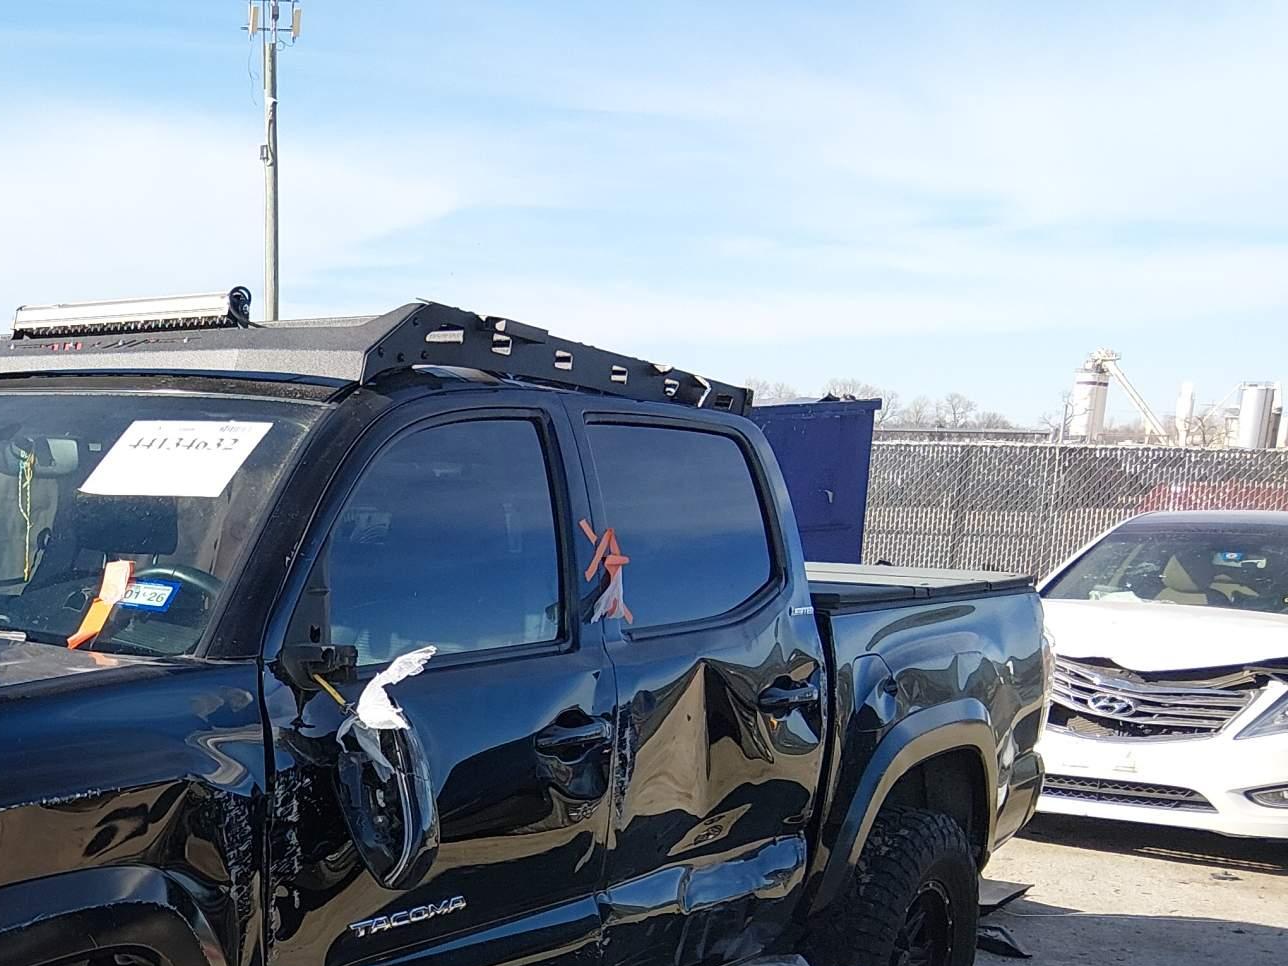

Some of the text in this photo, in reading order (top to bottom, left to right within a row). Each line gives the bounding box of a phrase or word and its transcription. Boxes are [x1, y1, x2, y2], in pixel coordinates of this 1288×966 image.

[123, 589, 167, 603] 01 26
[349, 895, 467, 938] TACOMA
